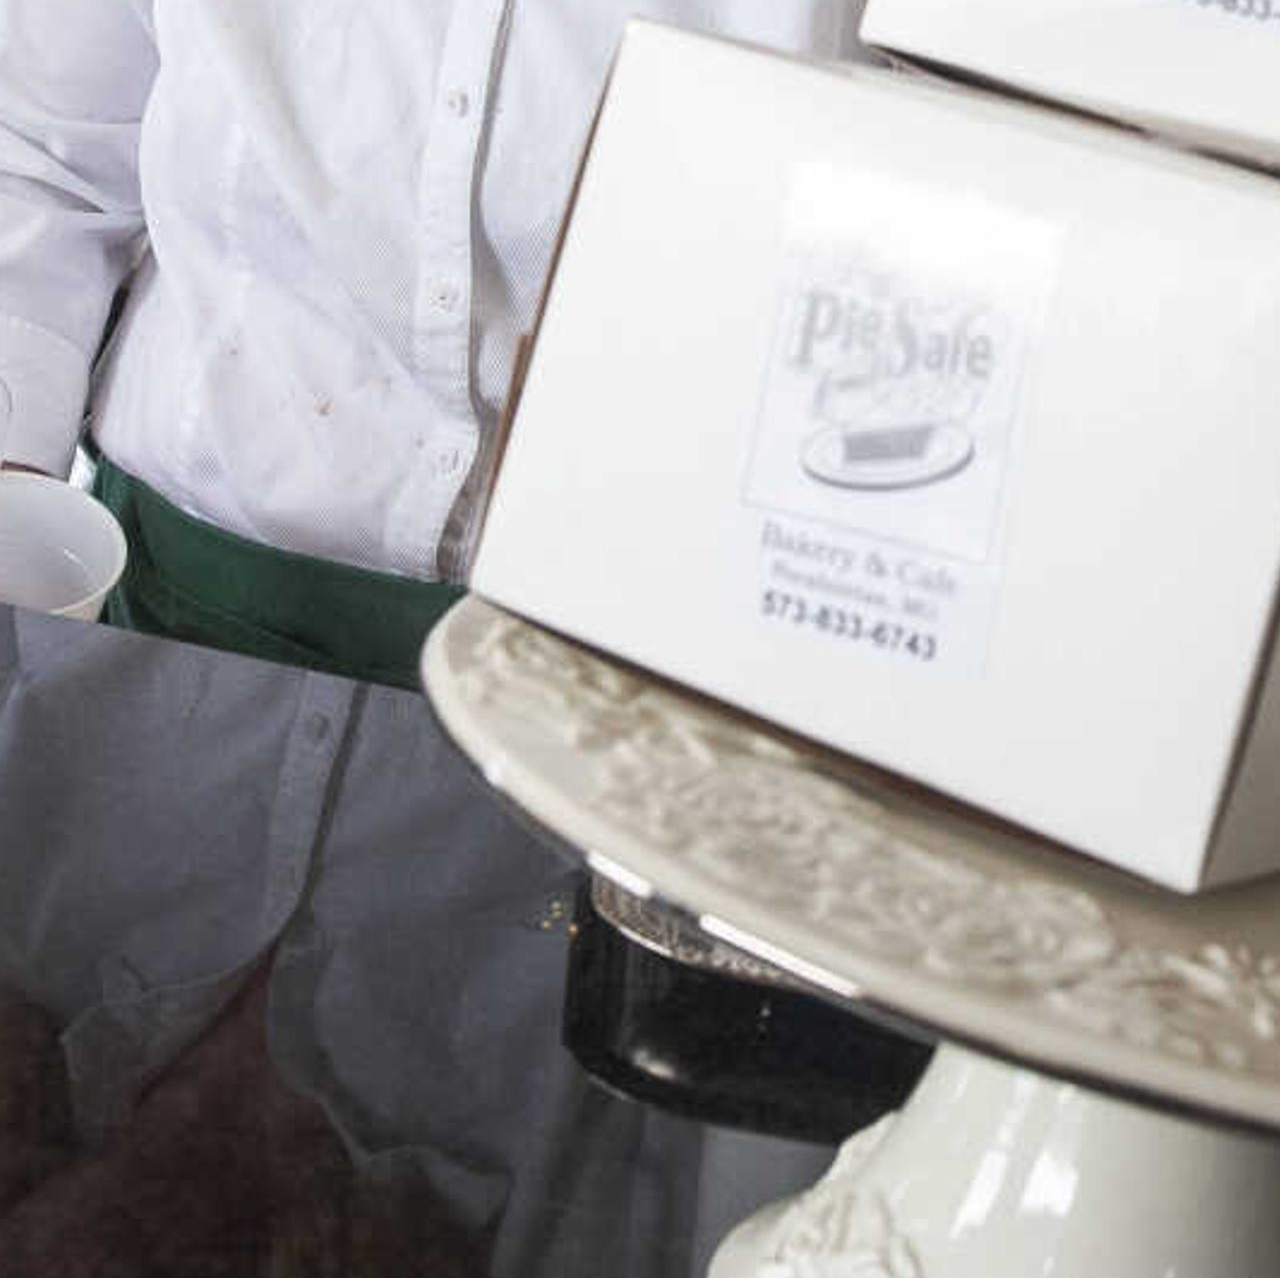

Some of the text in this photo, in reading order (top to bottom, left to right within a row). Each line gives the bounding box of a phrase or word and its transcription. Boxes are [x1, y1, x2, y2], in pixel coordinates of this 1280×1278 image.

[787, 288, 992, 381] Pie Safe
[761, 518, 856, 573] Bakery
[866, 551, 889, 578] &
[761, 588, 938, 662] 573-833-6743
